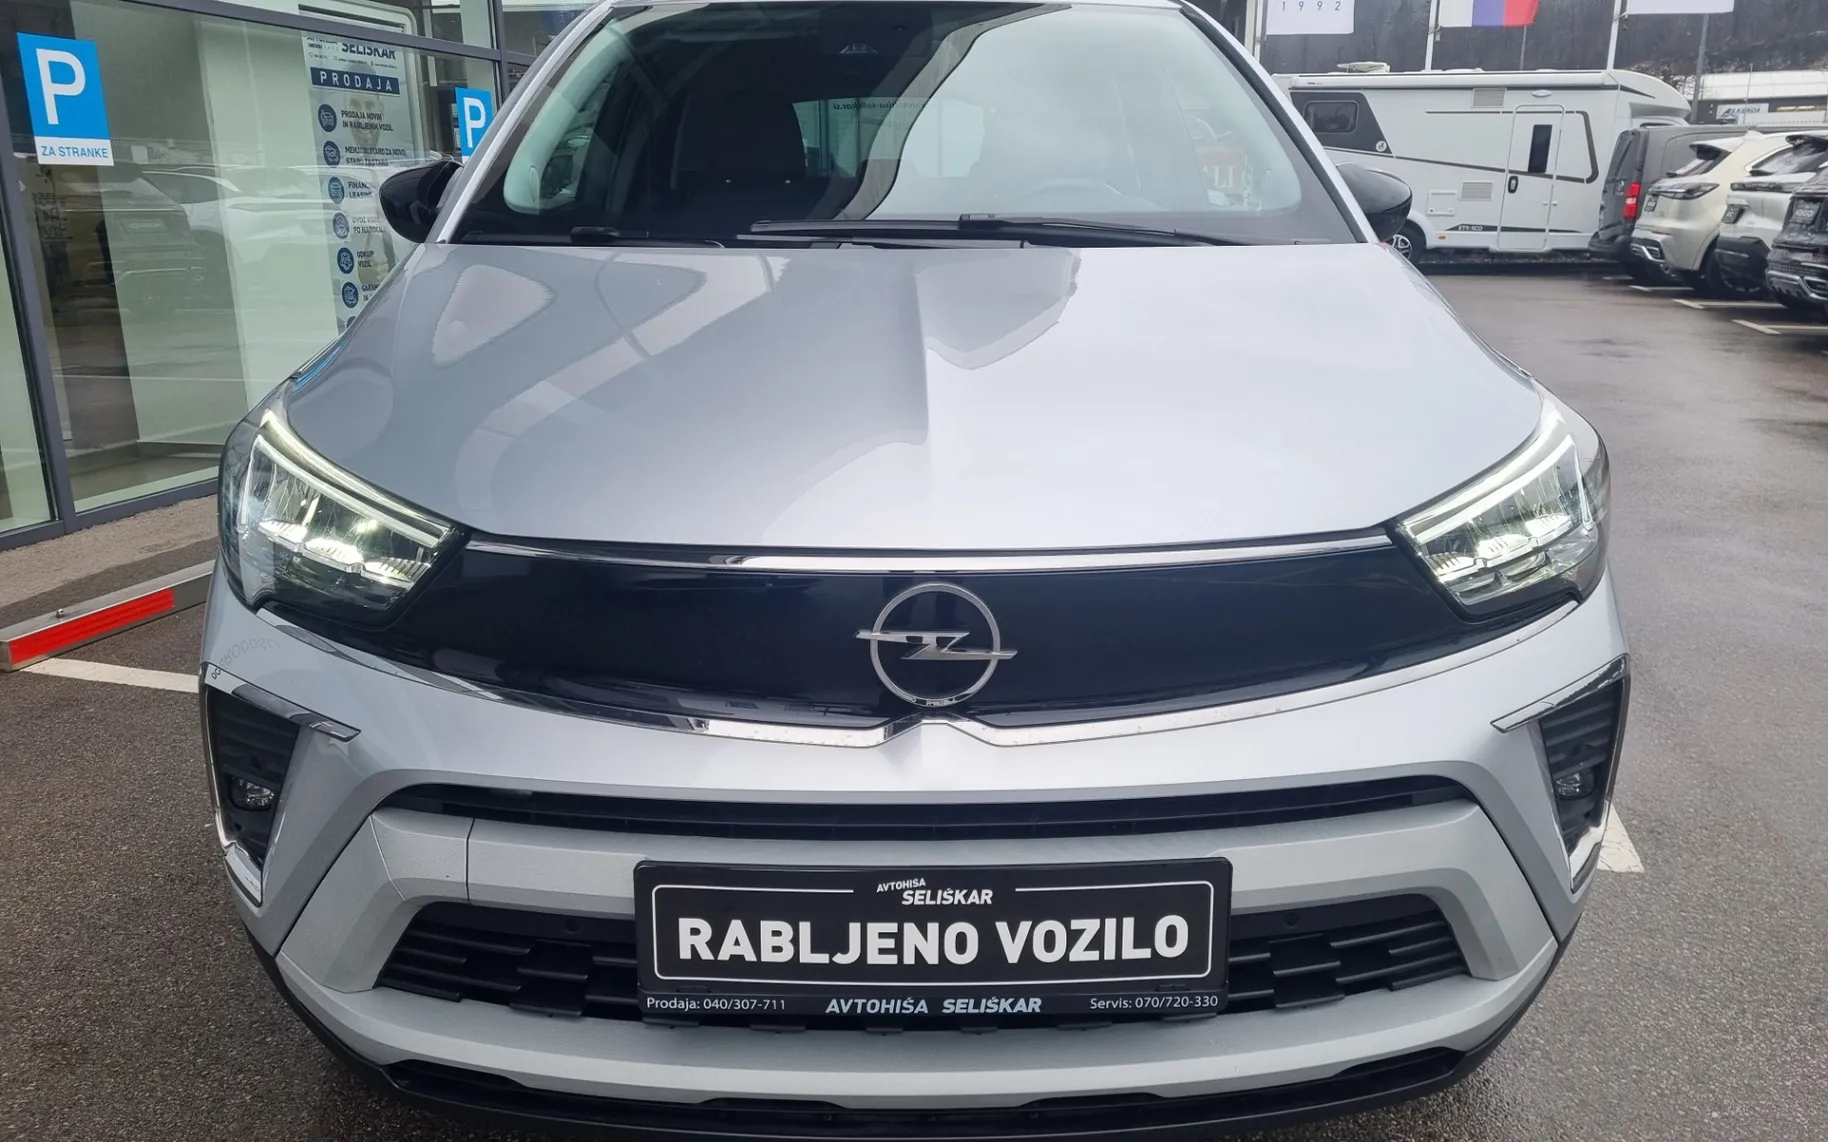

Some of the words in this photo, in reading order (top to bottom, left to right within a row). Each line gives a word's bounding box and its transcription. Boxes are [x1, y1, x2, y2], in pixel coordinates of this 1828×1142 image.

[1281, 1, 1341, 11] 1992
[36, 48, 86, 125] P
[320, 71, 392, 91] PRODAJA
[341, 110, 365, 119] PRODAJA
[463, 97, 486, 148] P
[41, 145, 57, 157] ZA
[58, 146, 109, 158] STRANKE
[877, 878, 926, 893] AVTOHIŠA
[901, 888, 993, 906] SELIŠKAR
[678, 918, 979, 965] RABLJENO
[995, 915, 1189, 964] VOZILO
[647, 997, 700, 1012] Prodaja:
[703, 998, 786, 1011] 040/307-711
[825, 996, 929, 1014] AVTOHIŠA
[942, 996, 1042, 1014] SELIŠKAR
[1090, 997, 1132, 1010] Servis:
[1135, 995, 1219, 1008] 070/720-330
